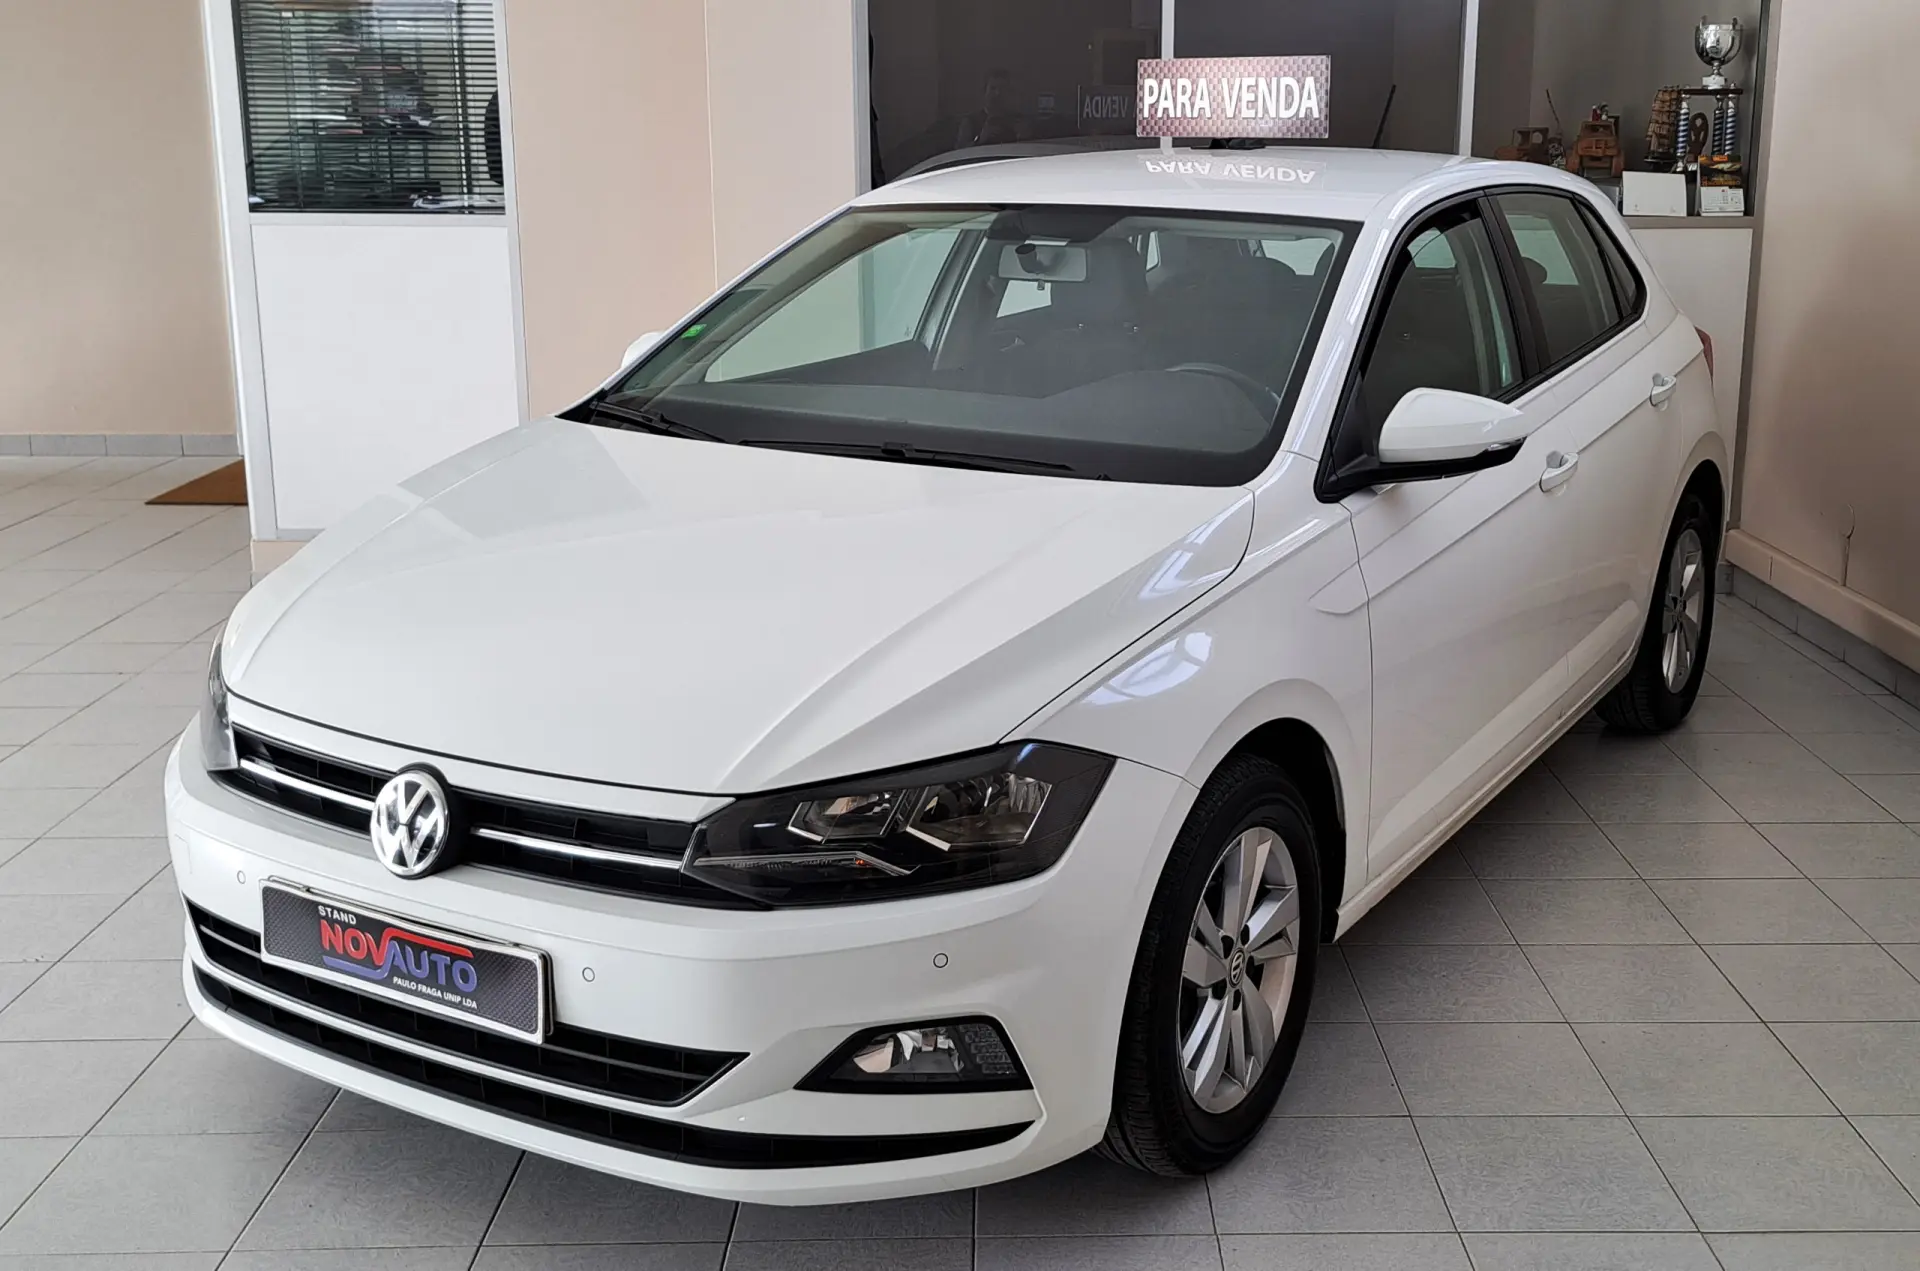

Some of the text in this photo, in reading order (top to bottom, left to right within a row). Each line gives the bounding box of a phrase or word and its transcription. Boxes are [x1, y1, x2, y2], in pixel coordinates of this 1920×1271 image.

[1143, 76, 1320, 118] PARA VENDA
[318, 905, 357, 925] STAND
[320, 919, 478, 993] NOVAUTO
[393, 976, 478, 1009] PAULO FRAGA UNIP LDA
